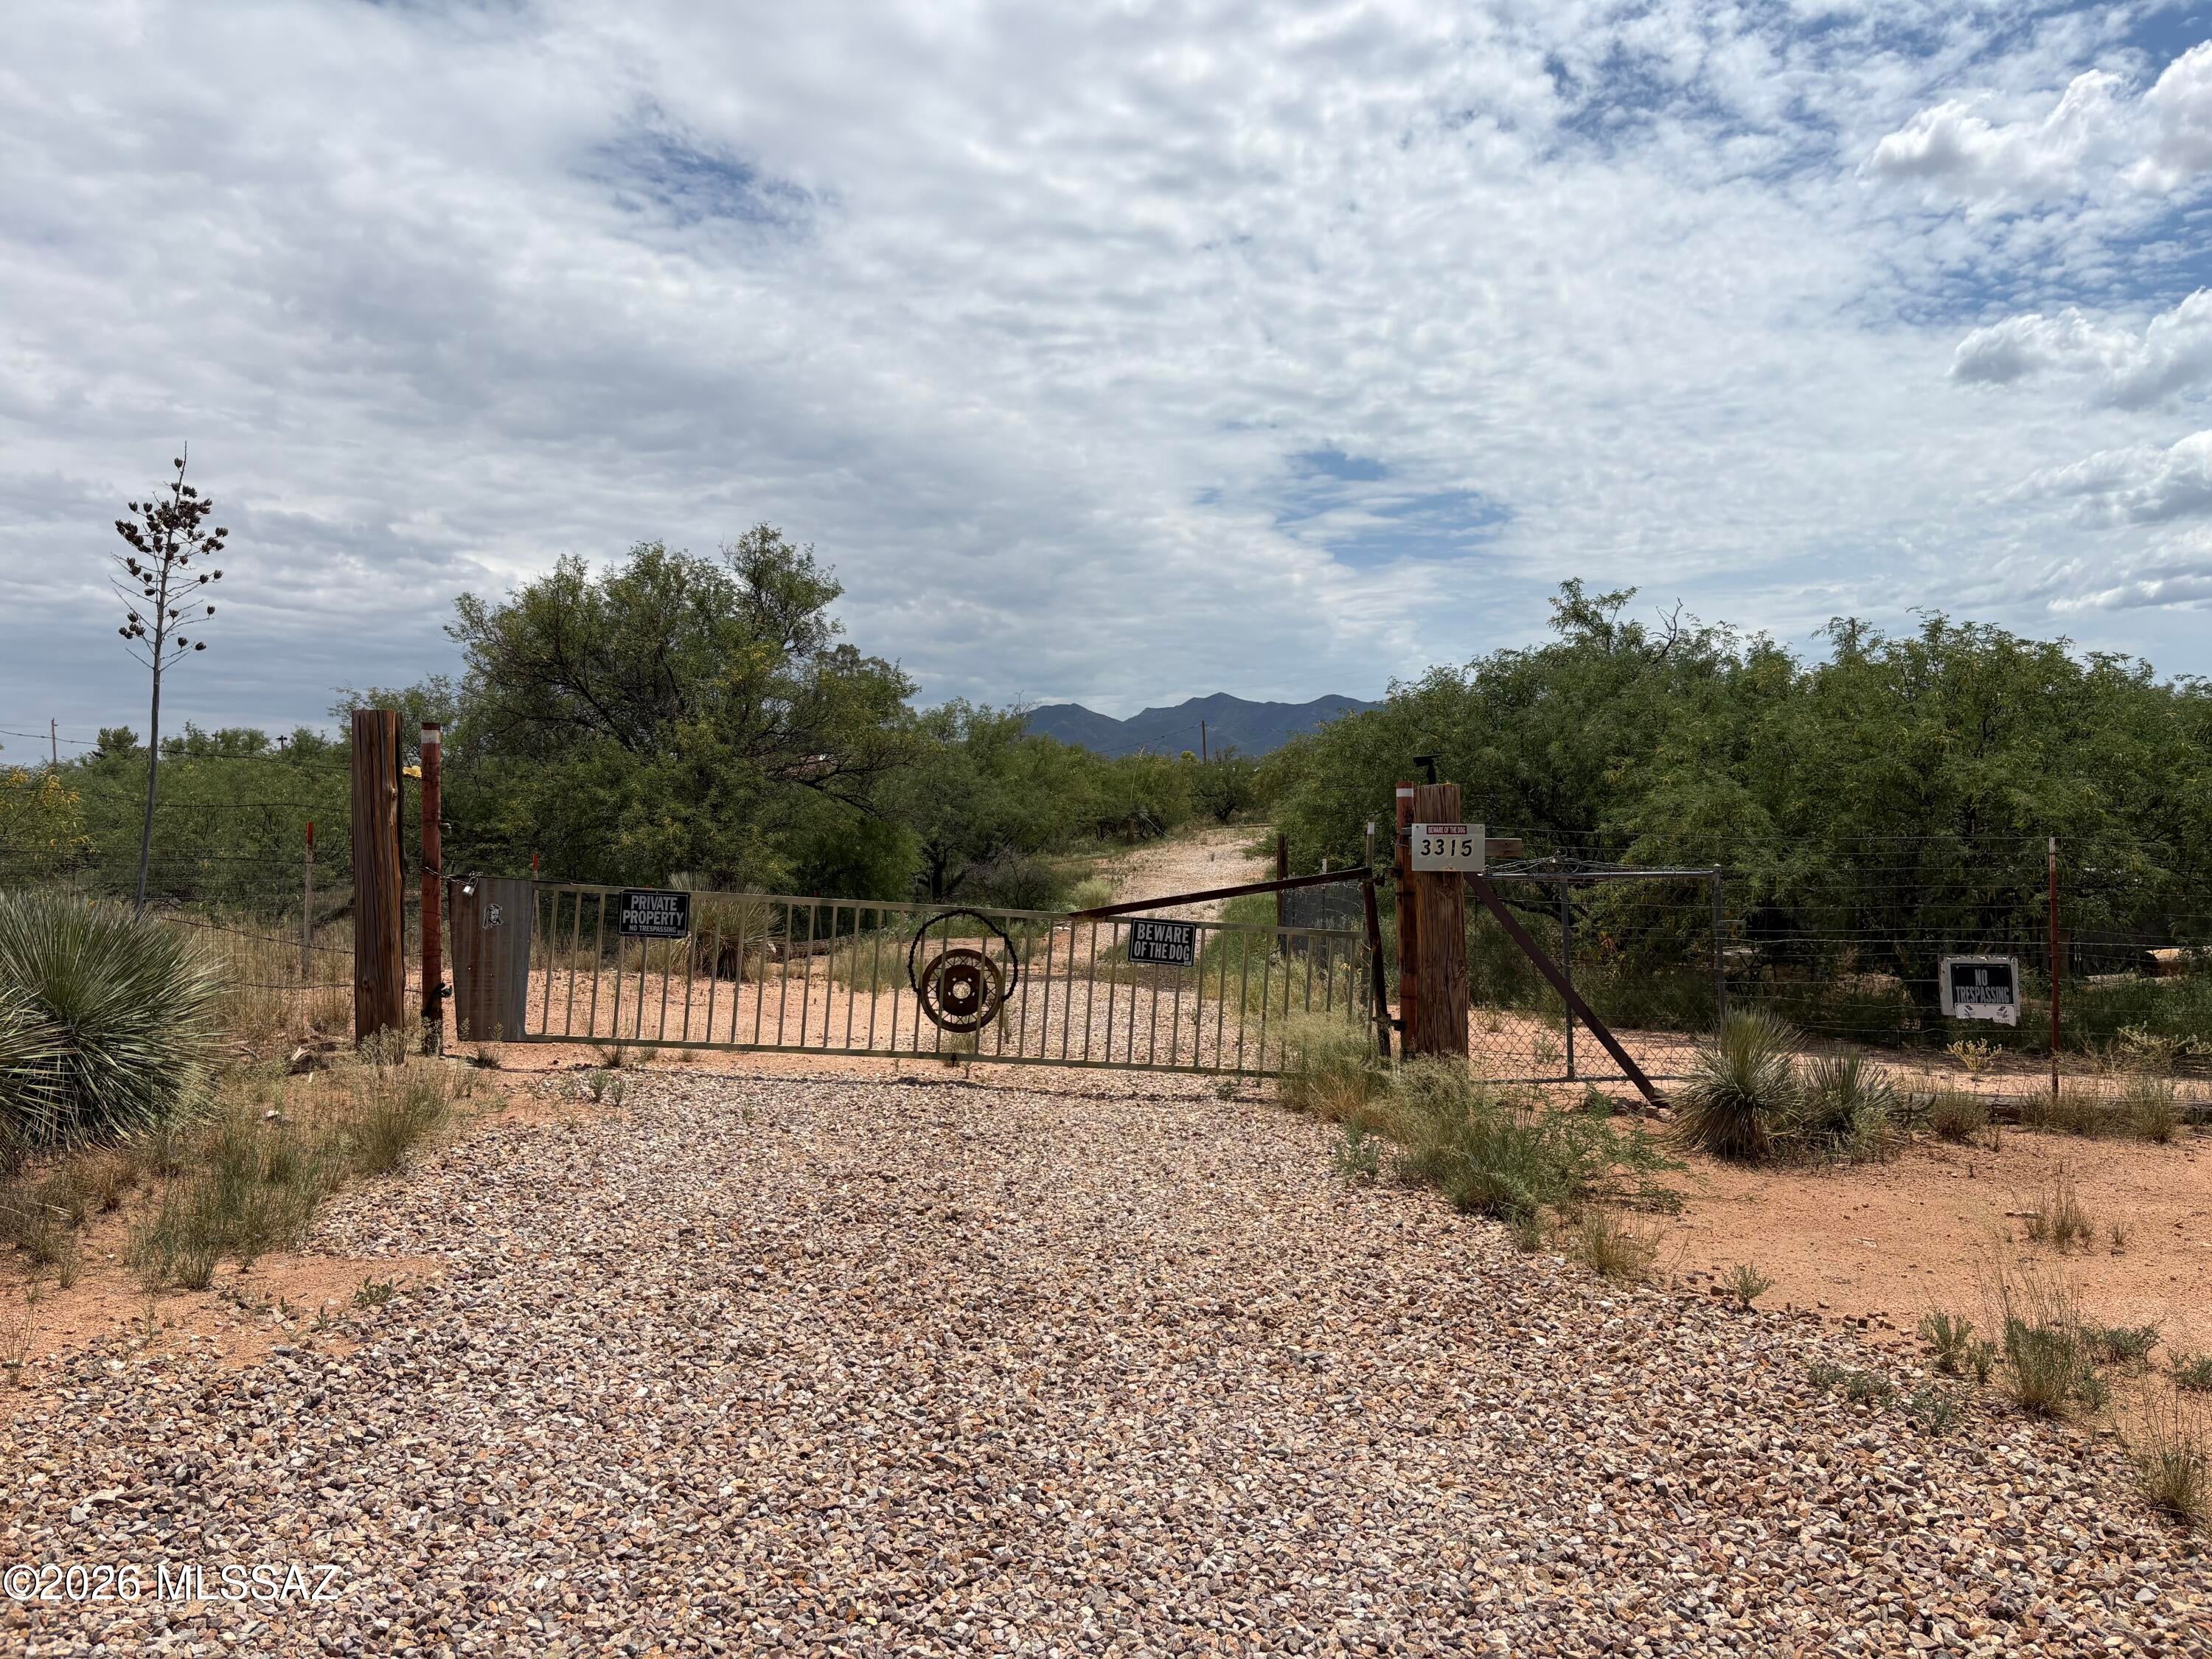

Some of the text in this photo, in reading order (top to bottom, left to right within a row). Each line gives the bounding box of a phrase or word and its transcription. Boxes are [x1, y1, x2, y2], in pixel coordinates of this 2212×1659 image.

[1420, 838, 1472, 857] 3315
[630, 895, 678, 911] PRIVATE
[622, 909, 684, 926] PROPERTY
[639, 925, 677, 933] TRESPASSING
[1137, 923, 1190, 944] BEWARE
[1133, 940, 1190, 961] OF THE DOG
[1975, 969, 1989, 987] NO
[1955, 986, 2010, 1004] TRESPASSING
